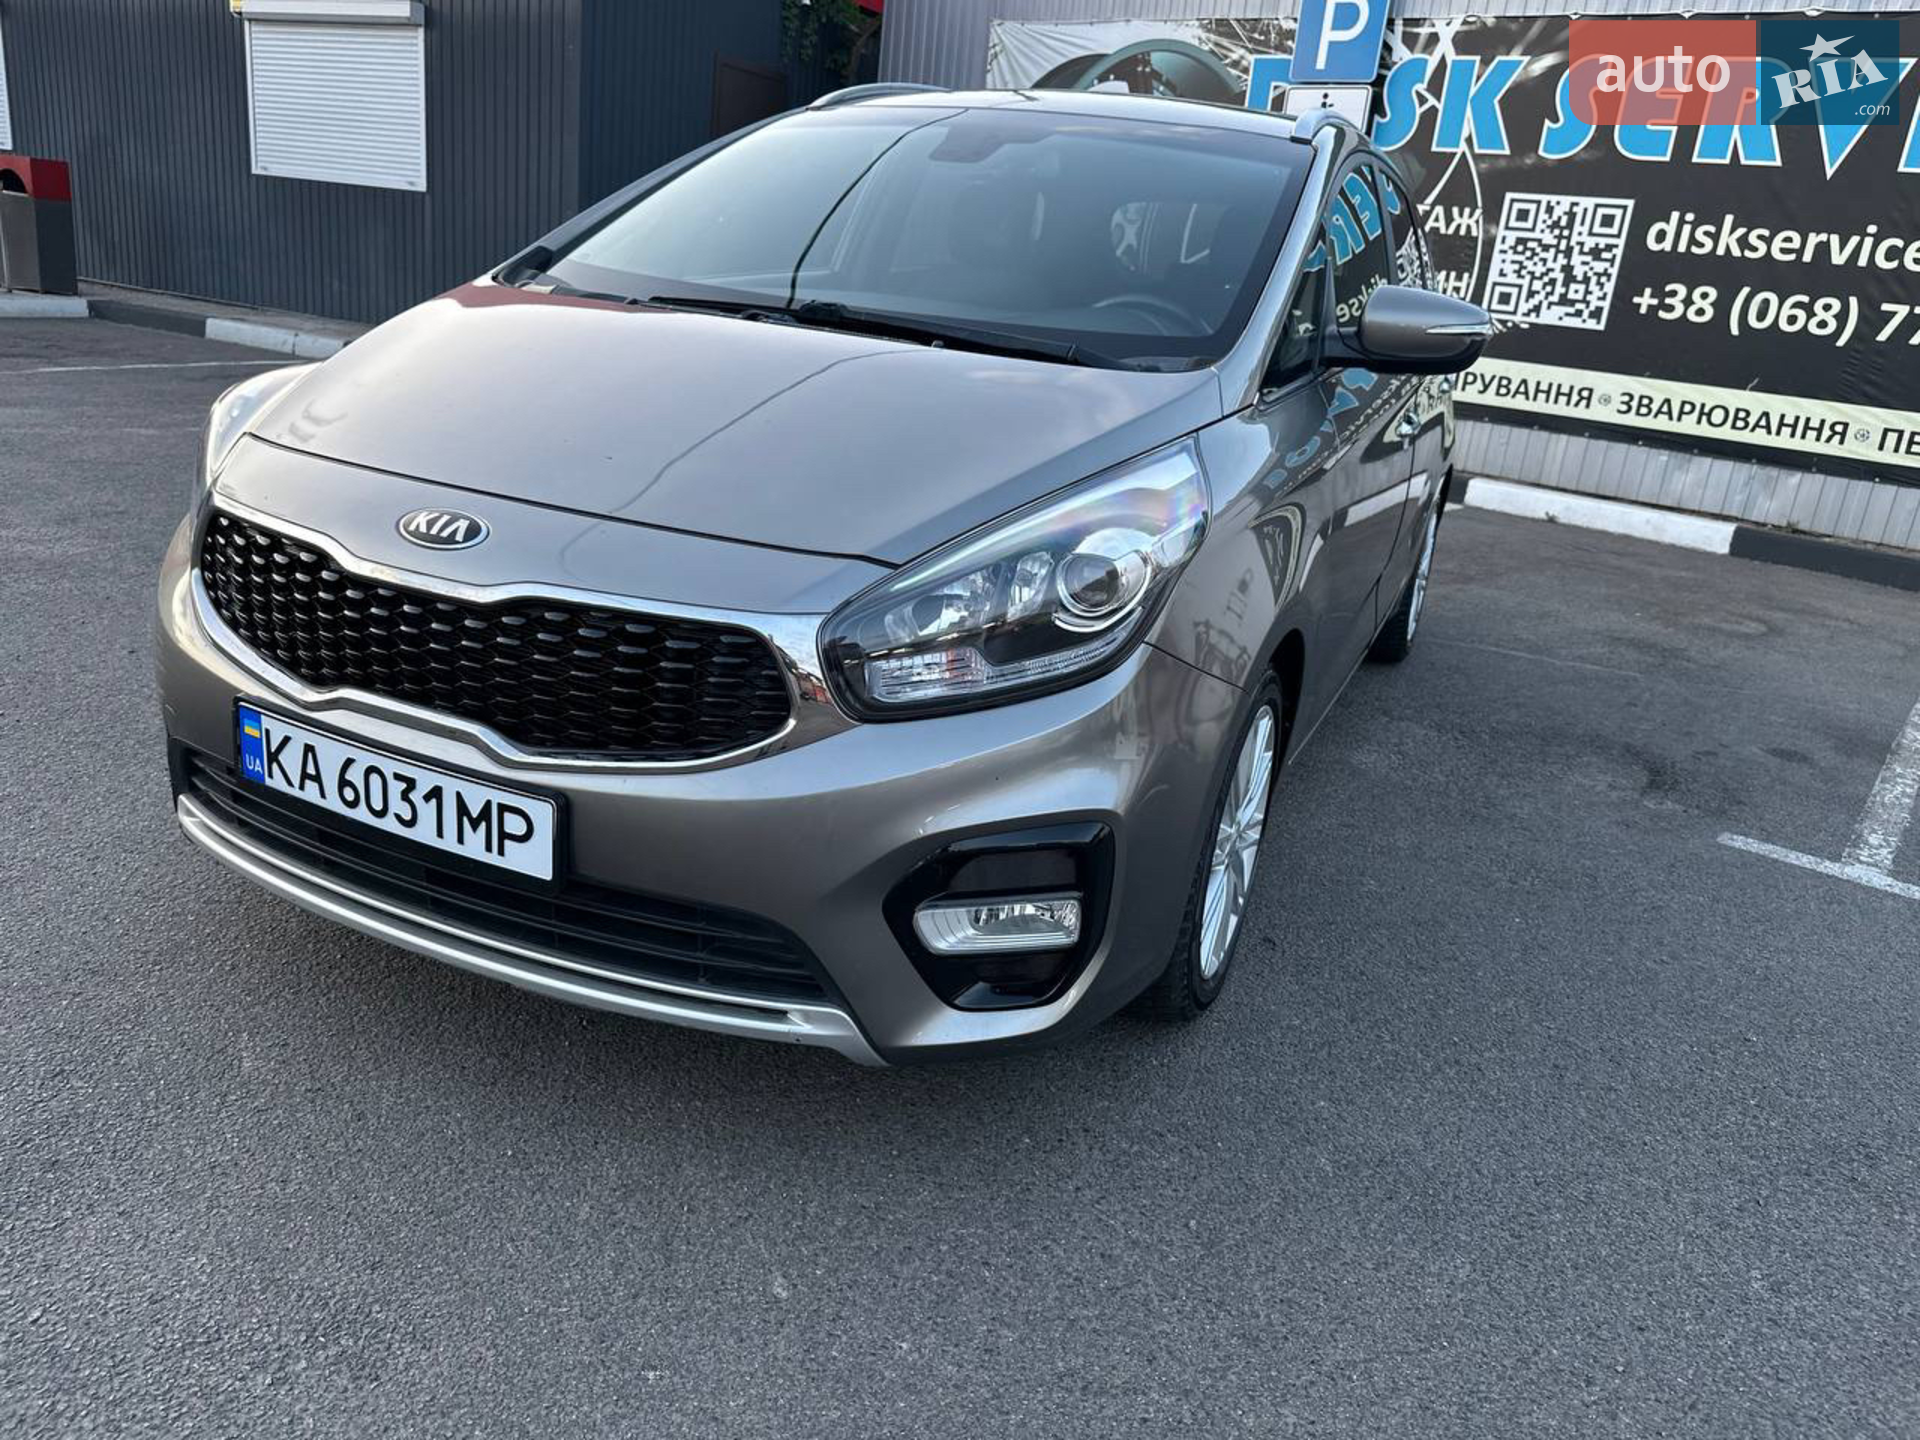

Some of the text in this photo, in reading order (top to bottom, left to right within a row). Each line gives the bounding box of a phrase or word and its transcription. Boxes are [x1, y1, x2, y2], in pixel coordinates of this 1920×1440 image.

[1315, 0, 1370, 70] P
[1646, 210, 1920, 272] diskservice
[1632, 282, 1718, 323] +38
[1729, 286, 1859, 347] (068)
[1616, 392, 1850, 446] ЗВАРЮВАННЯ
[408, 511, 470, 542] KIA
[245, 753, 263, 774] UA
